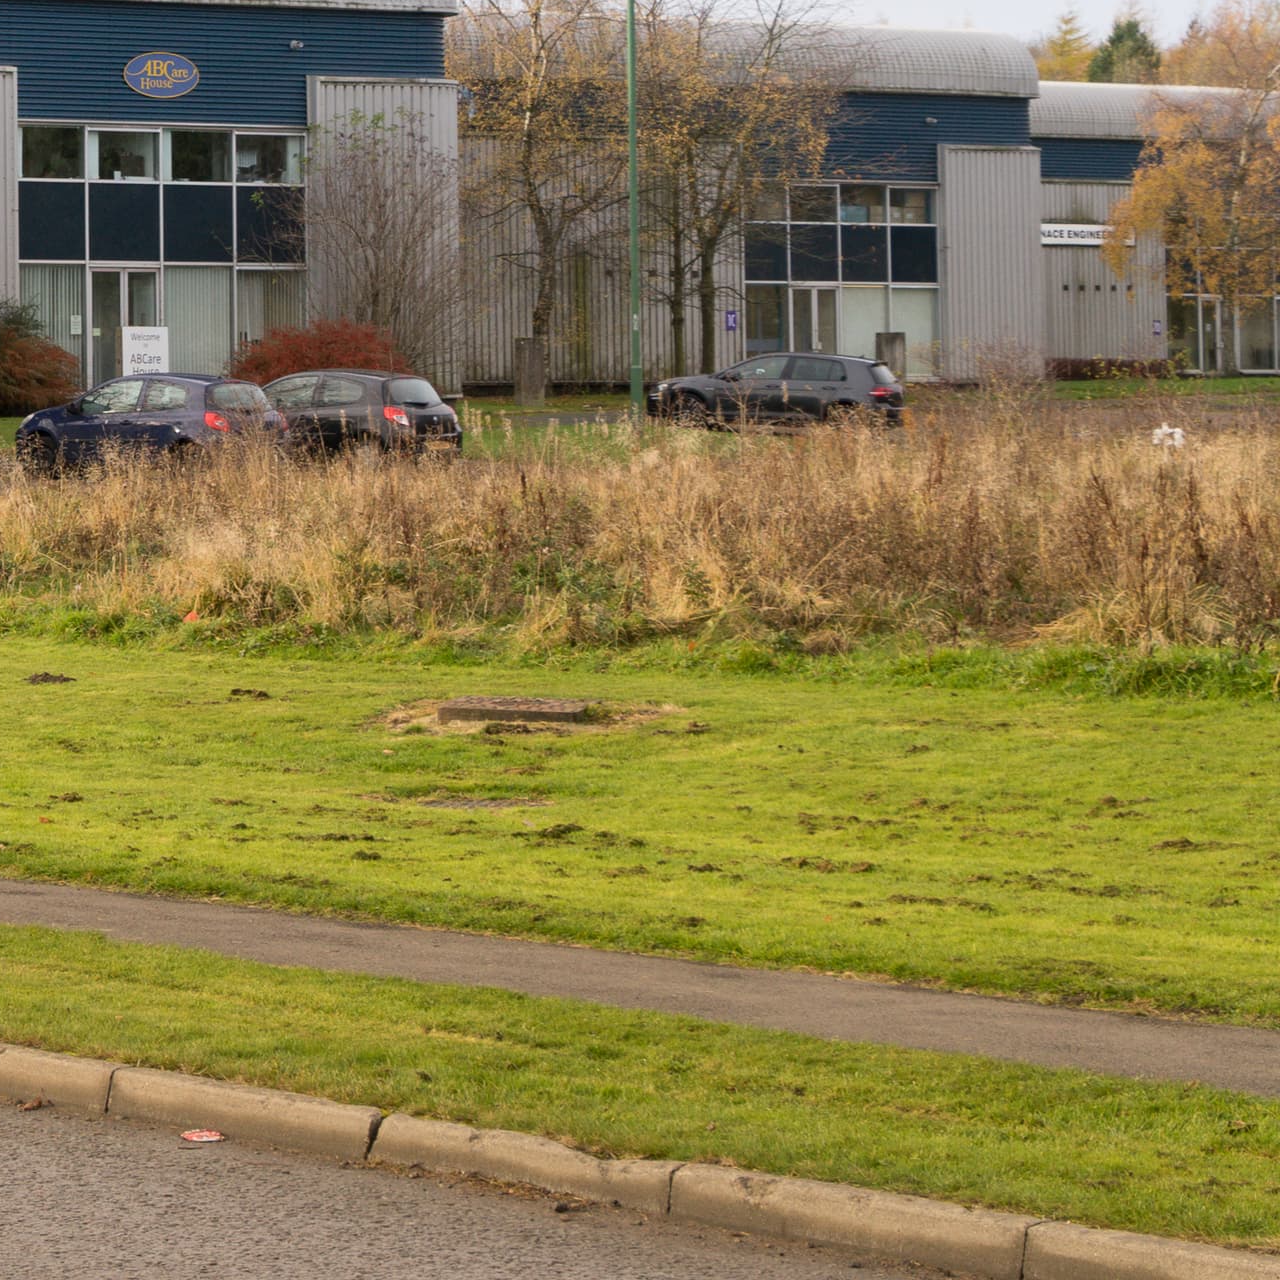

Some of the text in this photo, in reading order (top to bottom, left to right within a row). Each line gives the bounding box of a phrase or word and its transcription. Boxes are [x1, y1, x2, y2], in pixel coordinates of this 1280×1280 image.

[140, 77, 173, 89] House
[130, 332, 161, 341] Welcome
[130, 353, 162, 364] ABCare
